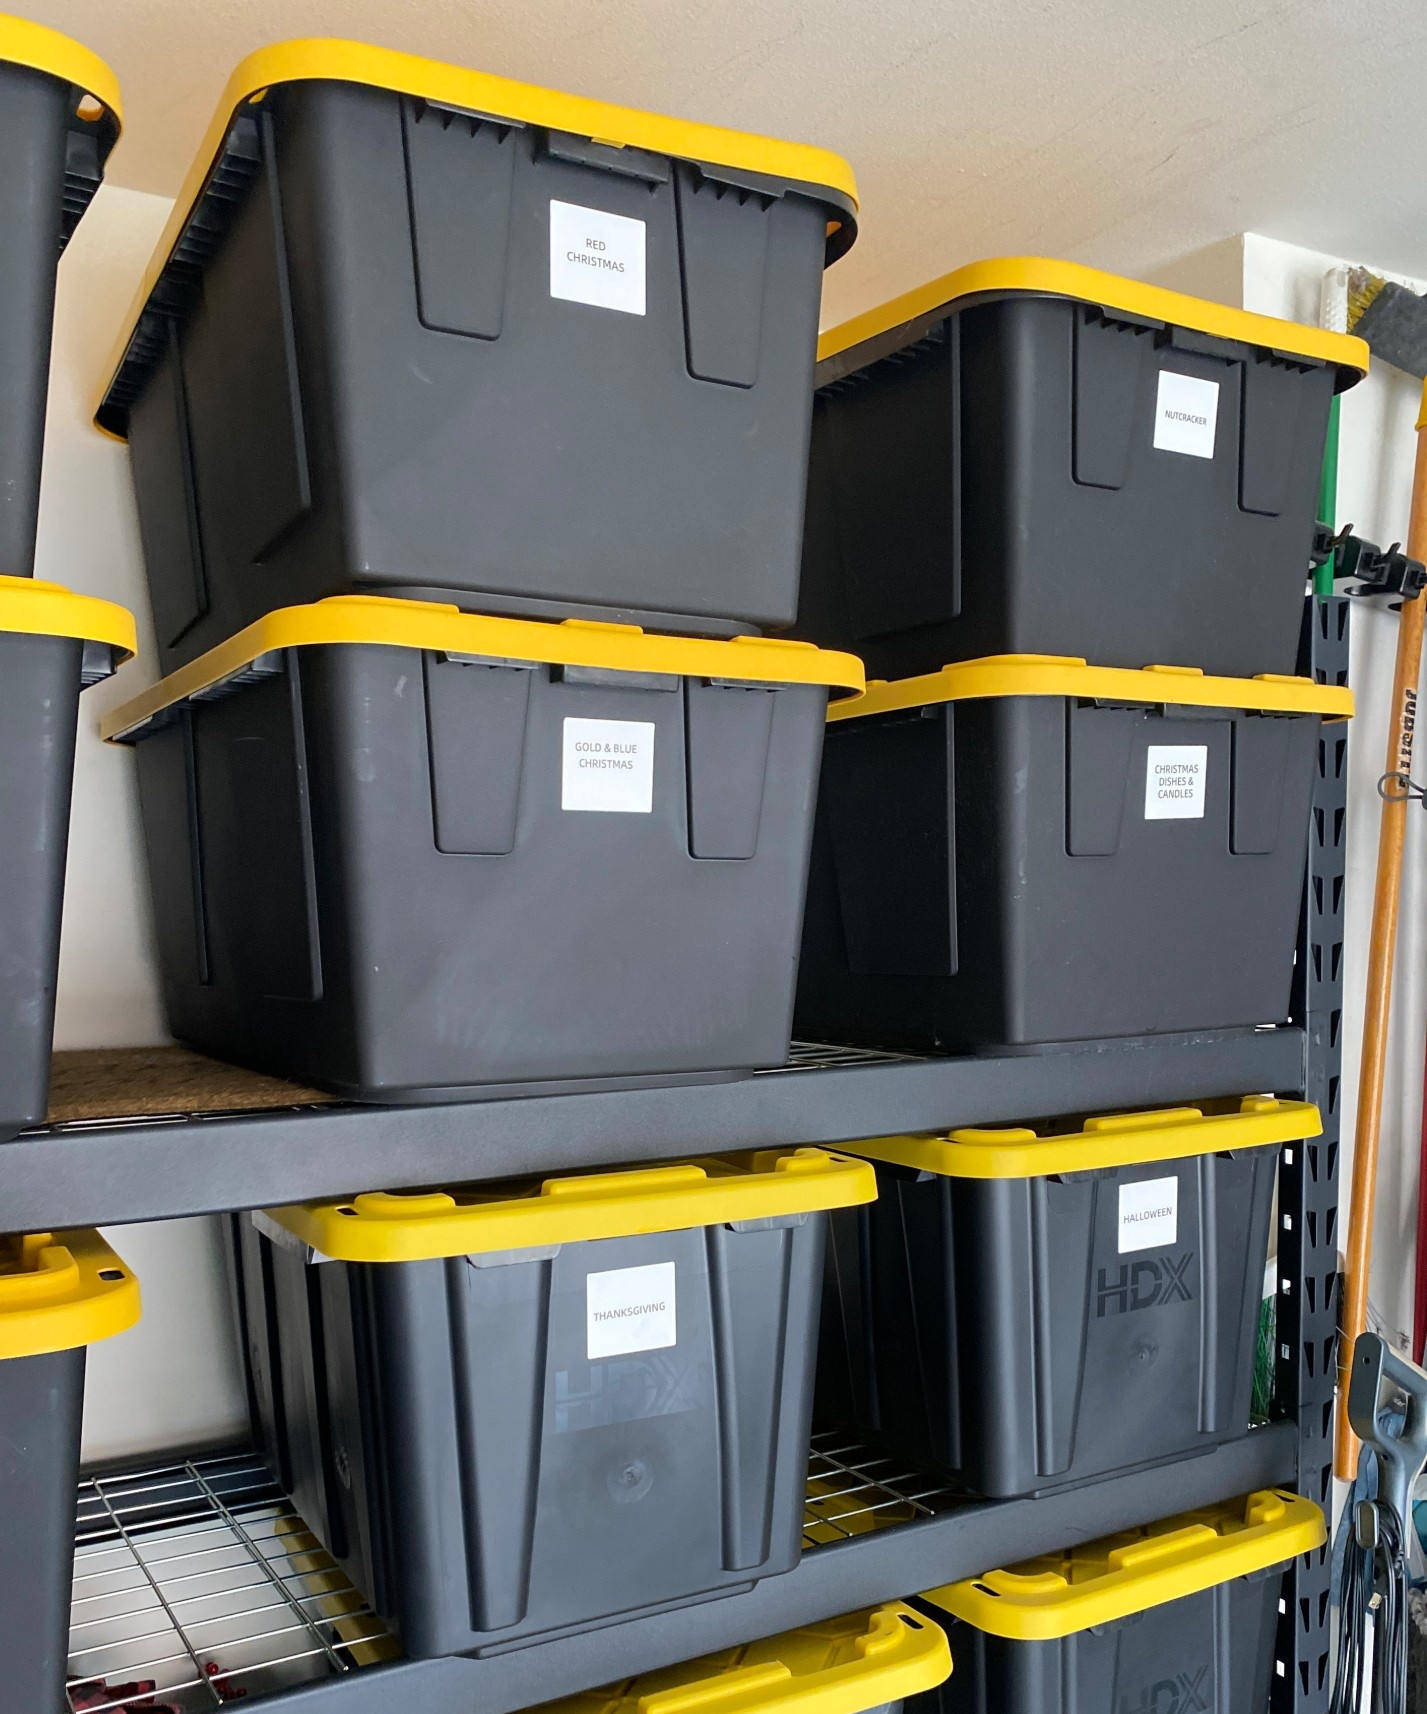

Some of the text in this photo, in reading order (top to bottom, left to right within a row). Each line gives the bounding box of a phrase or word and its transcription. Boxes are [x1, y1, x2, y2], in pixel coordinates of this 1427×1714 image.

[586, 238, 606, 251] RED
[566, 251, 625, 273] CHRISTMAS
[1164, 410, 1208, 426] NUTCRACKER
[575, 742, 638, 754] GOLD & BLUE
[579, 758, 634, 770] CHRISTMAS
[1154, 764, 1199, 774] CHRISTMAS
[1158, 776, 1194, 787] DISHES &
[1157, 788, 1194, 799] CANDLES
[1123, 1206, 1173, 1224] HALLOWEEN
[1097, 1252, 1195, 1318] HDX
[593, 1301, 666, 1322] THANKSGIVING
[554, 1354, 700, 1433] HDX
